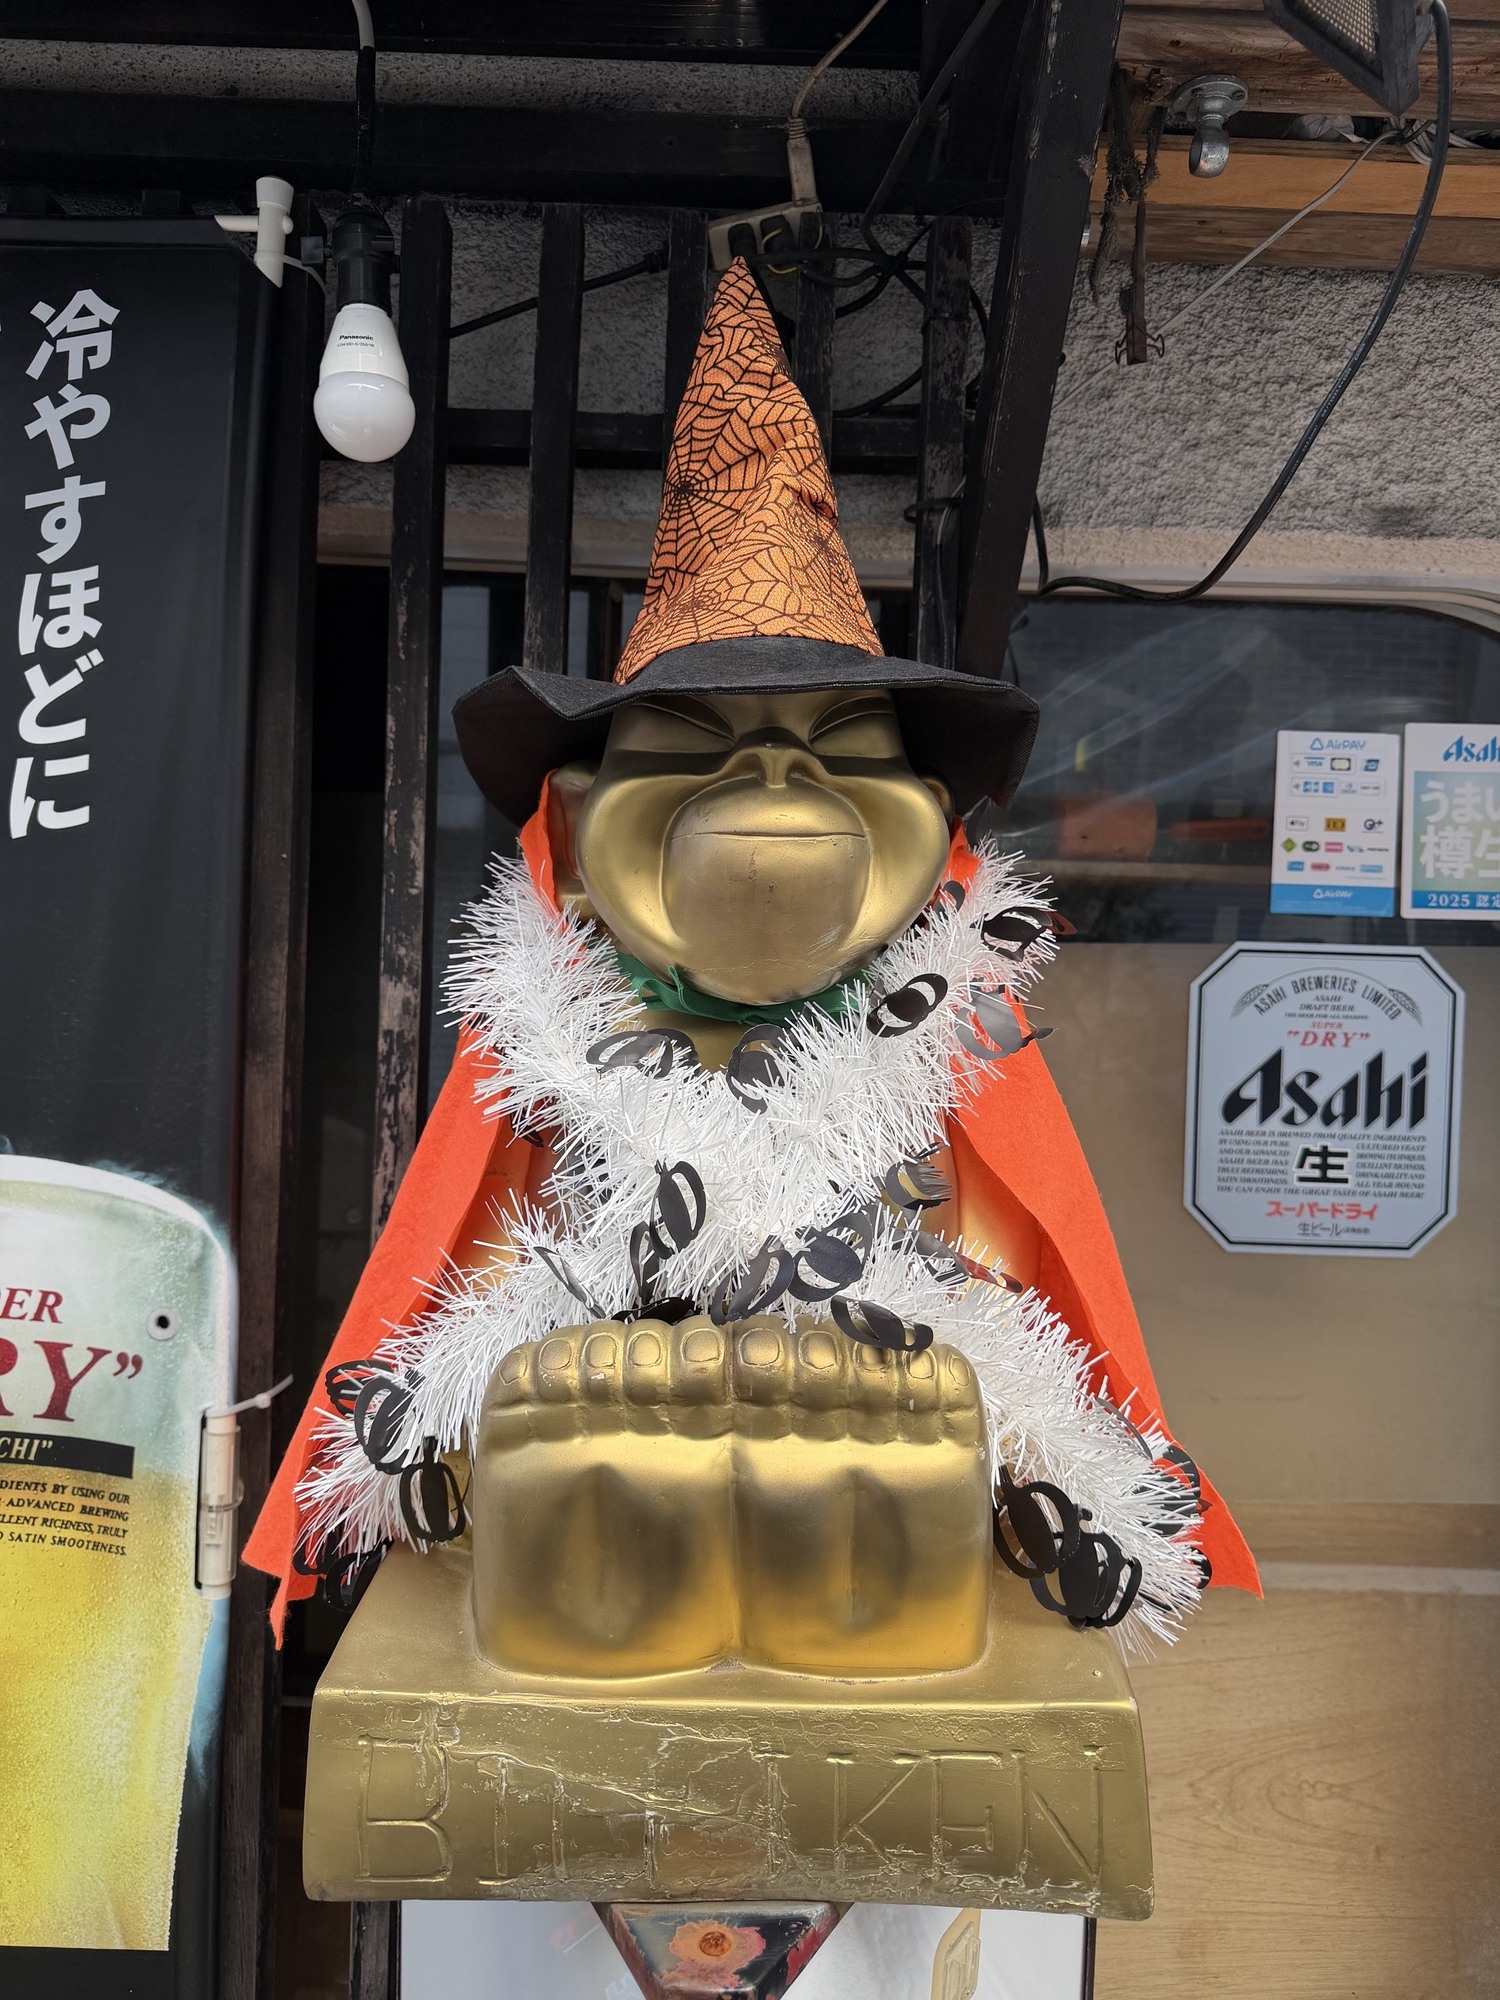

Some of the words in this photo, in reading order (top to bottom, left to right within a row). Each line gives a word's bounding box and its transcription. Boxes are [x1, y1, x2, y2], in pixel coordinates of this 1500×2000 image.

[9, 288, 120, 839] 冷やすほどに
[1326, 740, 1366, 750] AirPAY
[1428, 893, 1470, 908] 2025
[1253, 985, 1288, 1016] ASAHI
[1291, 975, 1357, 995] BREWERIES
[1360, 984, 1402, 1020] LIMITED
[1313, 994, 1342, 1002] ASAHI
[1299, 1003, 1329, 1011] DRAFT
[1330, 1004, 1355, 1012] BEER
[1311, 1021, 1343, 1029] SUPER
[1222, 1048, 1428, 1129] Asahi
[1338, 1133, 1371, 1141] QUALITY
[1296, 1145, 1349, 1184] 生
[1265, 1200, 1377, 1221] スーパードライ
[0, 1287, 63, 1324] ER
[52, 1484, 68, 1495] BY
[72, 1486, 105, 1500] USING
[109, 1492, 130, 1505] OUR
[6, 1498, 75, 1512] ADVANCED
[80, 1504, 129, 1521] BREWING
[8, 1531, 47, 1544] SATIN
[97, 1524, 129, 1538] TRULY
